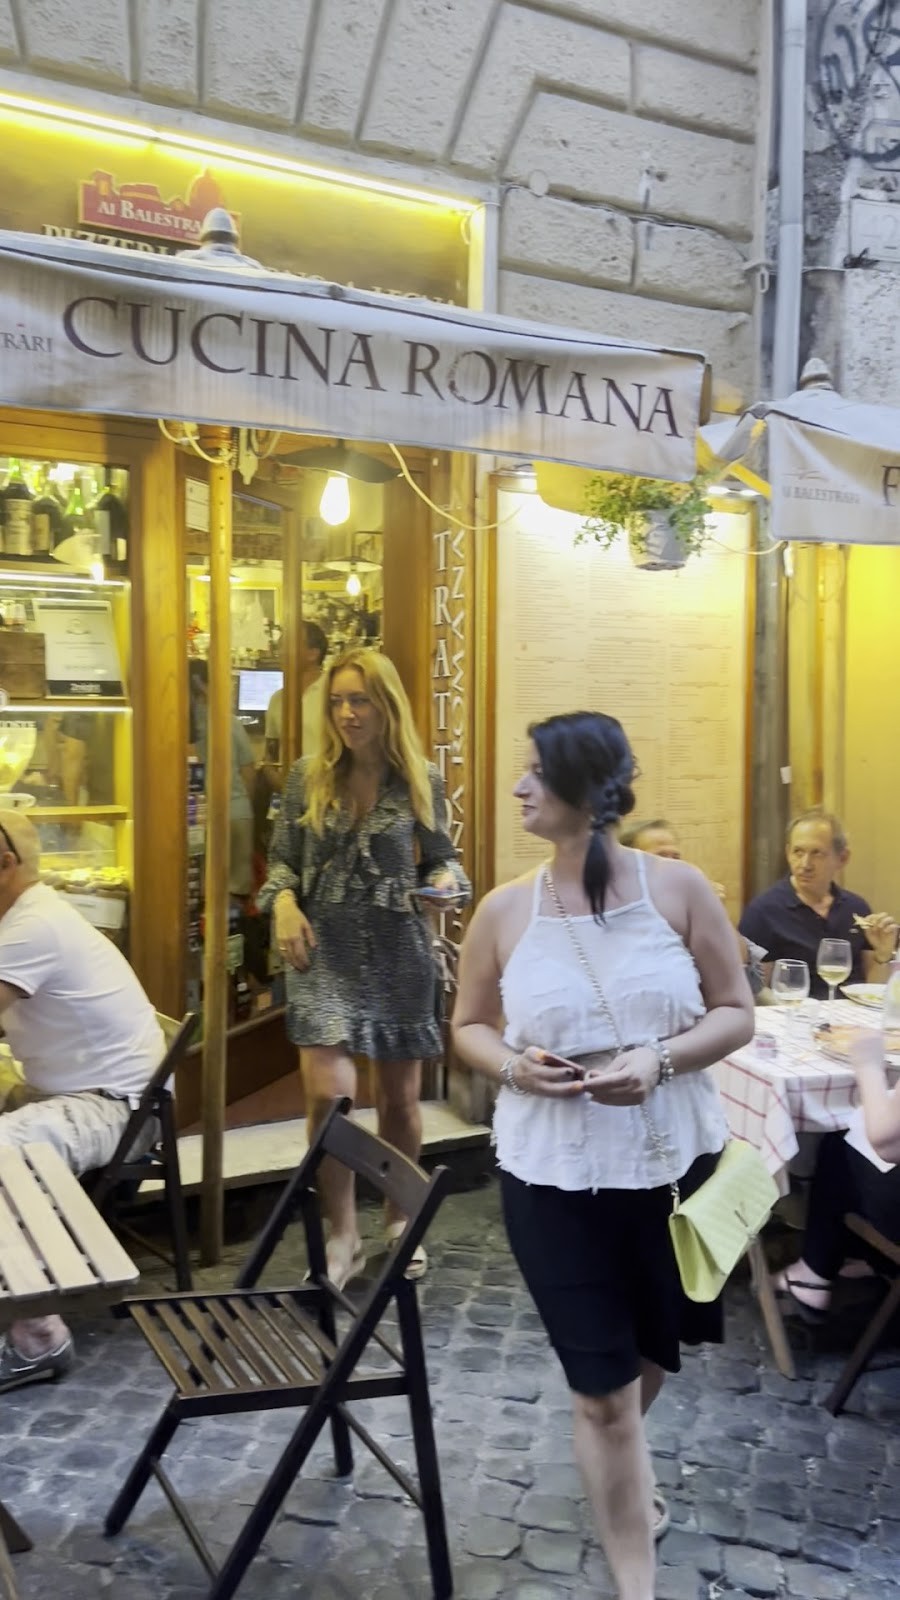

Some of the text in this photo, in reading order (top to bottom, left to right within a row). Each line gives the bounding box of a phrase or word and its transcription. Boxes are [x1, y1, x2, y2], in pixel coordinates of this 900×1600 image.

[120, 199, 202, 235] BALESTRA
[0, 331, 54, 353] RARI
[62, 296, 686, 438] CUCINA ROMANA
